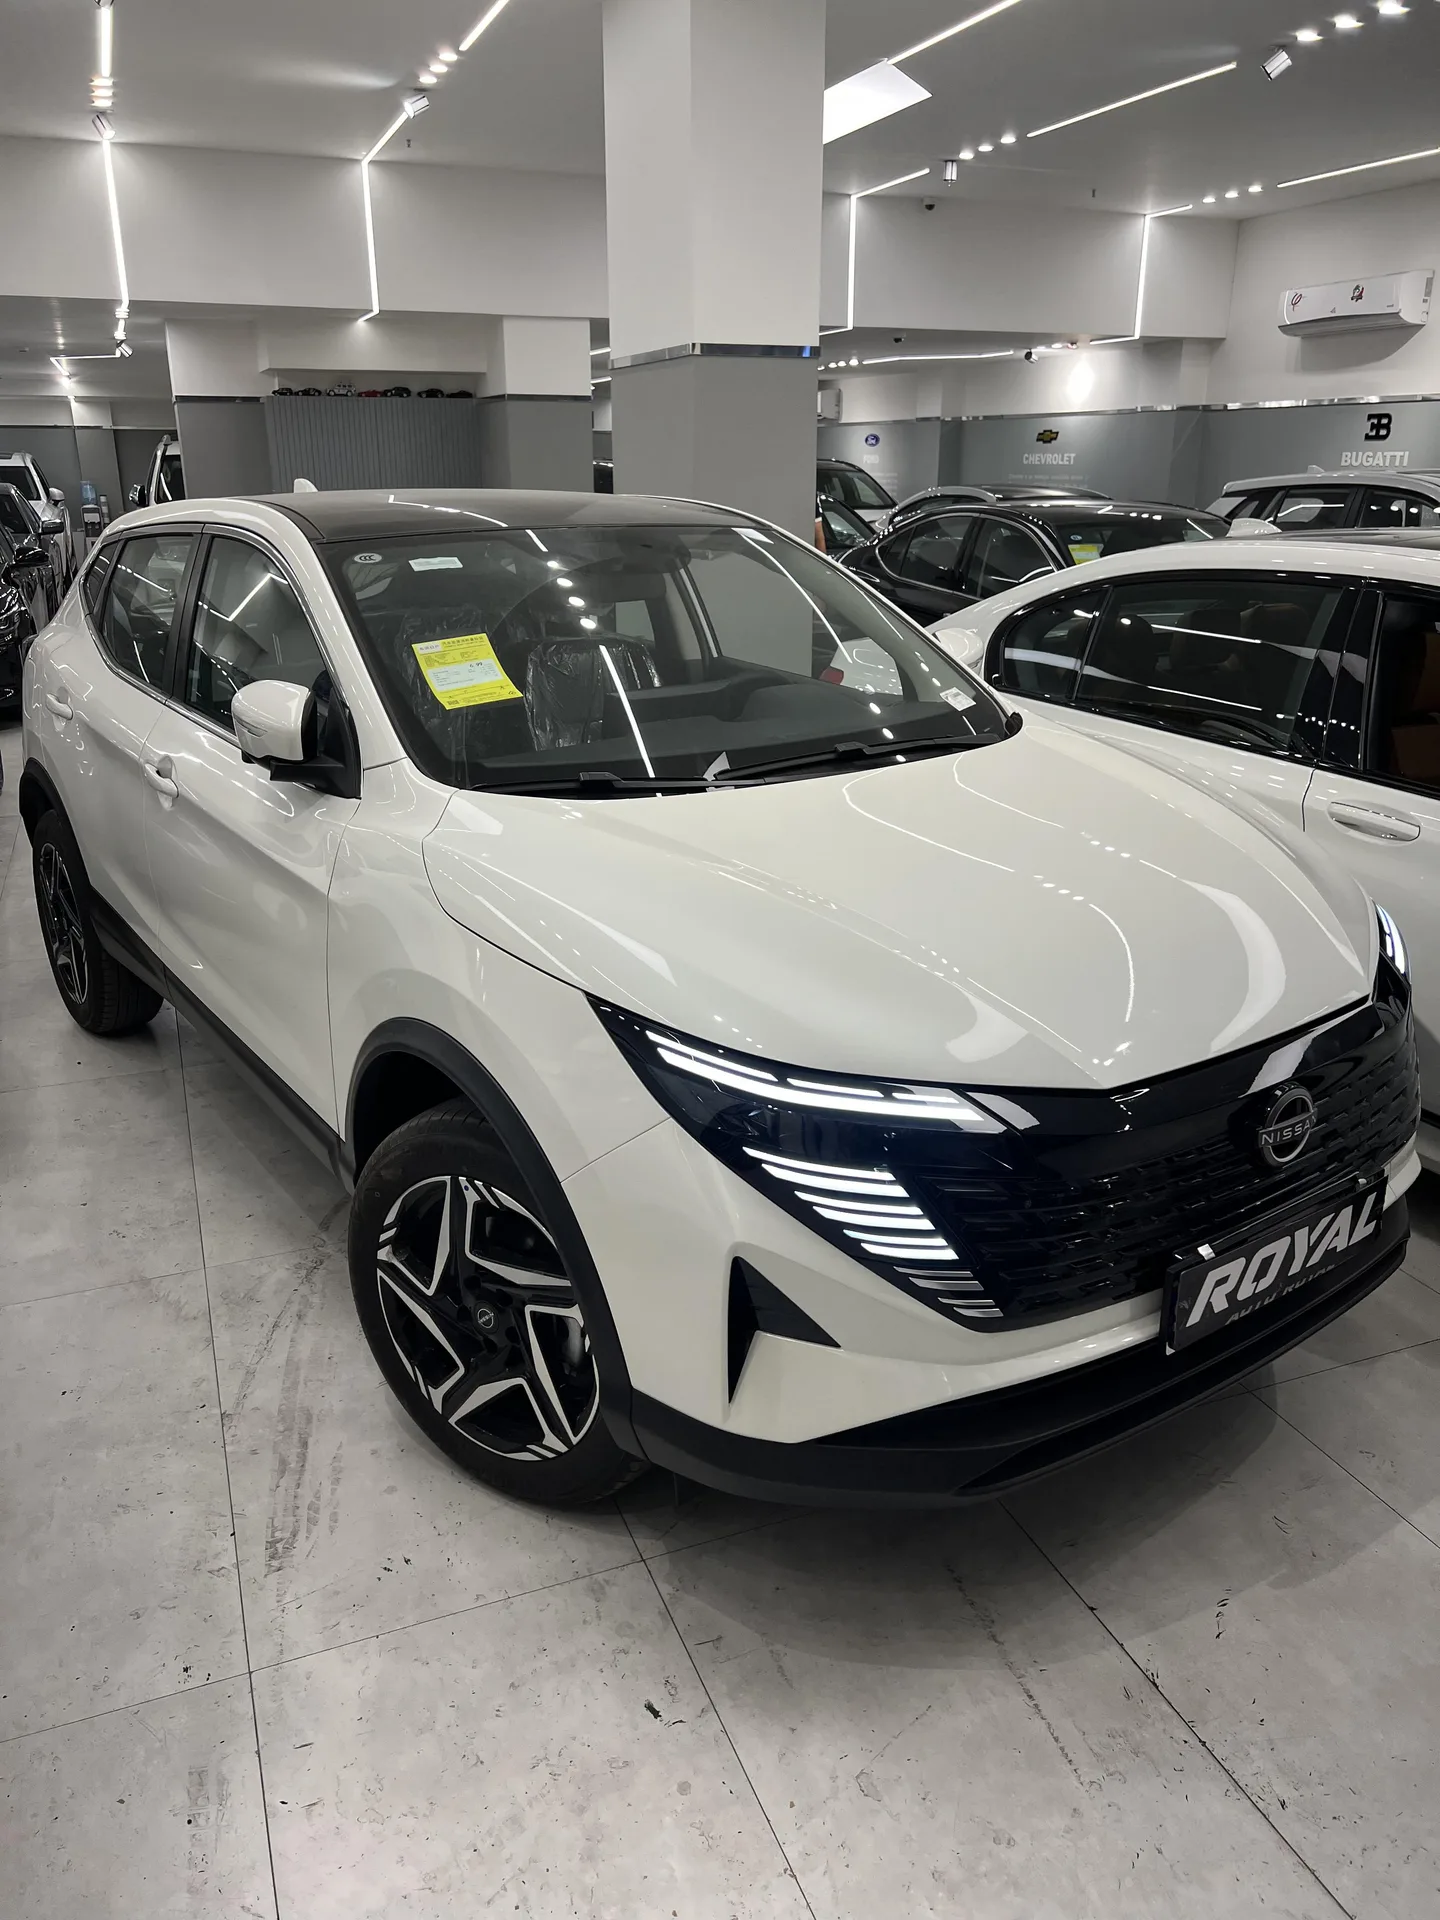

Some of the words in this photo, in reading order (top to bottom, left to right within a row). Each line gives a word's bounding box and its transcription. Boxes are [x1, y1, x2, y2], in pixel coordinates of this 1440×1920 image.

[1023, 453, 1076, 465] CHEVROLET
[1340, 451, 1409, 467] BUGATTI
[1185, 1191, 1377, 1328] ROYAL
